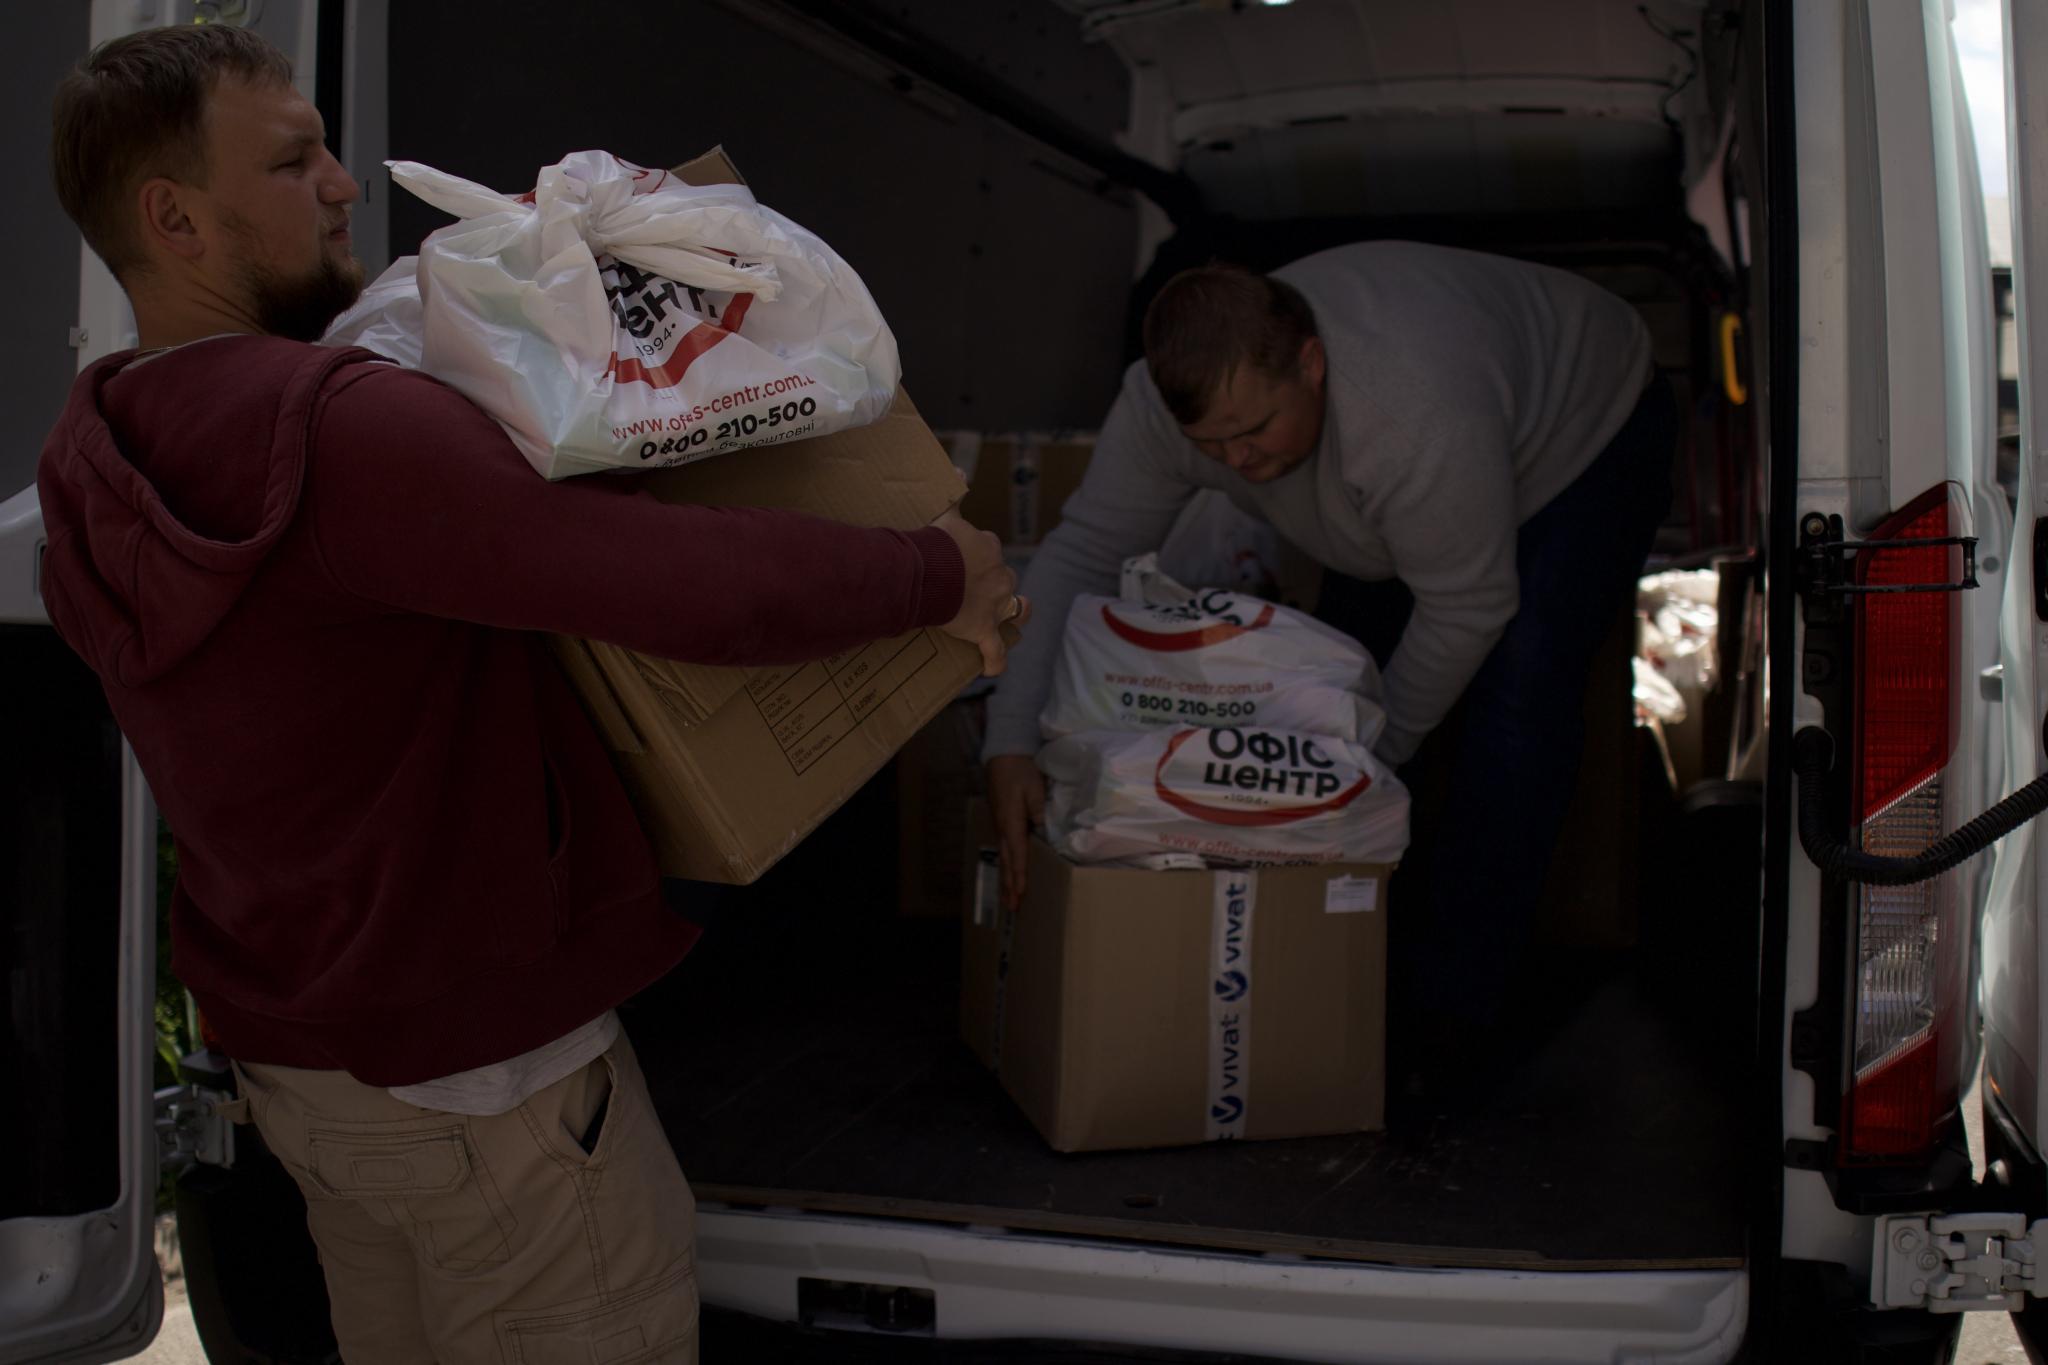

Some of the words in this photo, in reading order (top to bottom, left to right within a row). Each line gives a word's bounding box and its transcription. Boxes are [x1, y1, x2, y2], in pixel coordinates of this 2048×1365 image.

[636, 325, 672, 357] 1994
[715, 396, 817, 441] 210-500
[1122, 692, 1133, 707] 0
[1138, 695, 1173, 711] 800
[1178, 699, 1255, 718] 210-500
[1208, 727, 1336, 770] ОФІС
[1226, 882, 1247, 963] vivat
[1222, 1013, 1242, 1091] vivat
